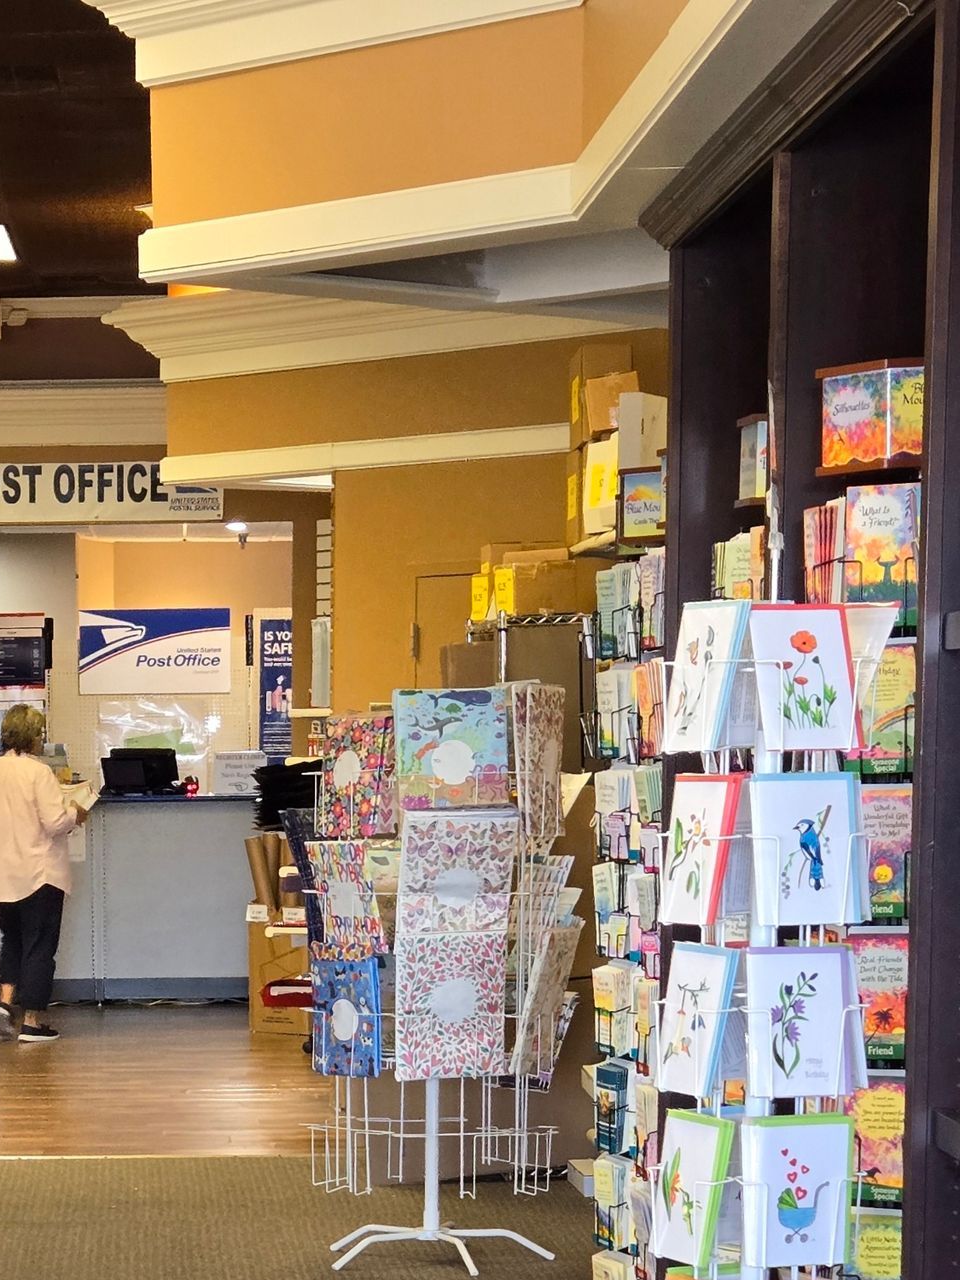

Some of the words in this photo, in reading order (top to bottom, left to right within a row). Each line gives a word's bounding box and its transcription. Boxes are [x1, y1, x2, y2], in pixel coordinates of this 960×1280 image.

[833, 399, 870, 416] Silhouettes
[53, 463, 169, 504] OFFICE
[862, 505, 881, 516] What
[264, 631, 274, 641] IS
[136, 655, 172, 667] Post
[174, 654, 221, 667] Office
[873, 765, 897, 774] Special
[858, 956, 875, 965] Real
[878, 955, 903, 964] Friends
[878, 965, 904, 975] Change
[889, 975, 904, 983] Tide
[868, 1046, 894, 1056] Friend
[873, 1192, 896, 1202] Special
